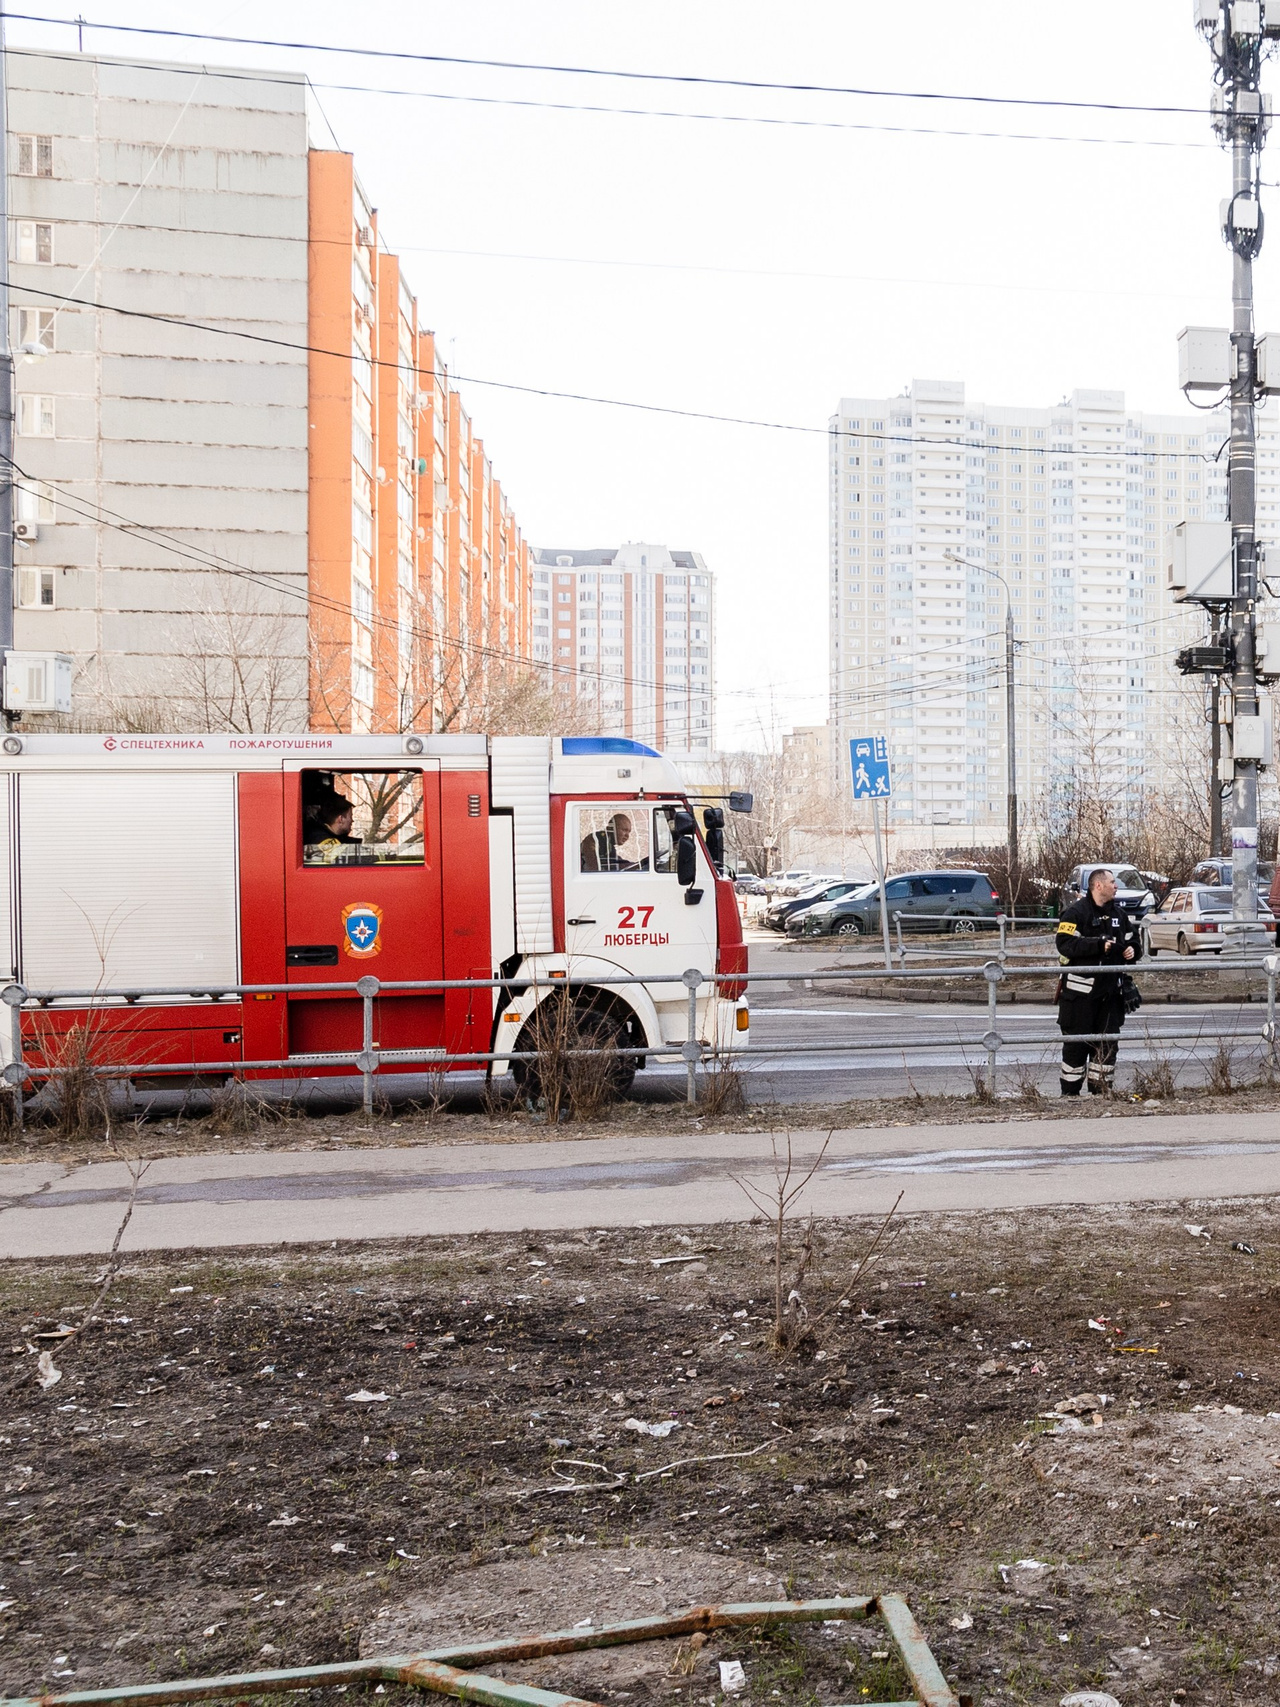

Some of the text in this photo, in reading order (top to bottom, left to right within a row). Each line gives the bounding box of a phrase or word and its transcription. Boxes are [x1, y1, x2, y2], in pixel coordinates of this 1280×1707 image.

[120, 739, 333, 750] СПЕЦТЕХНИКА ПОЖАРОТУШЕНИЯ
[617, 906, 655, 928] 27
[603, 932, 669, 947] ЛЮБЕРЦЫ
